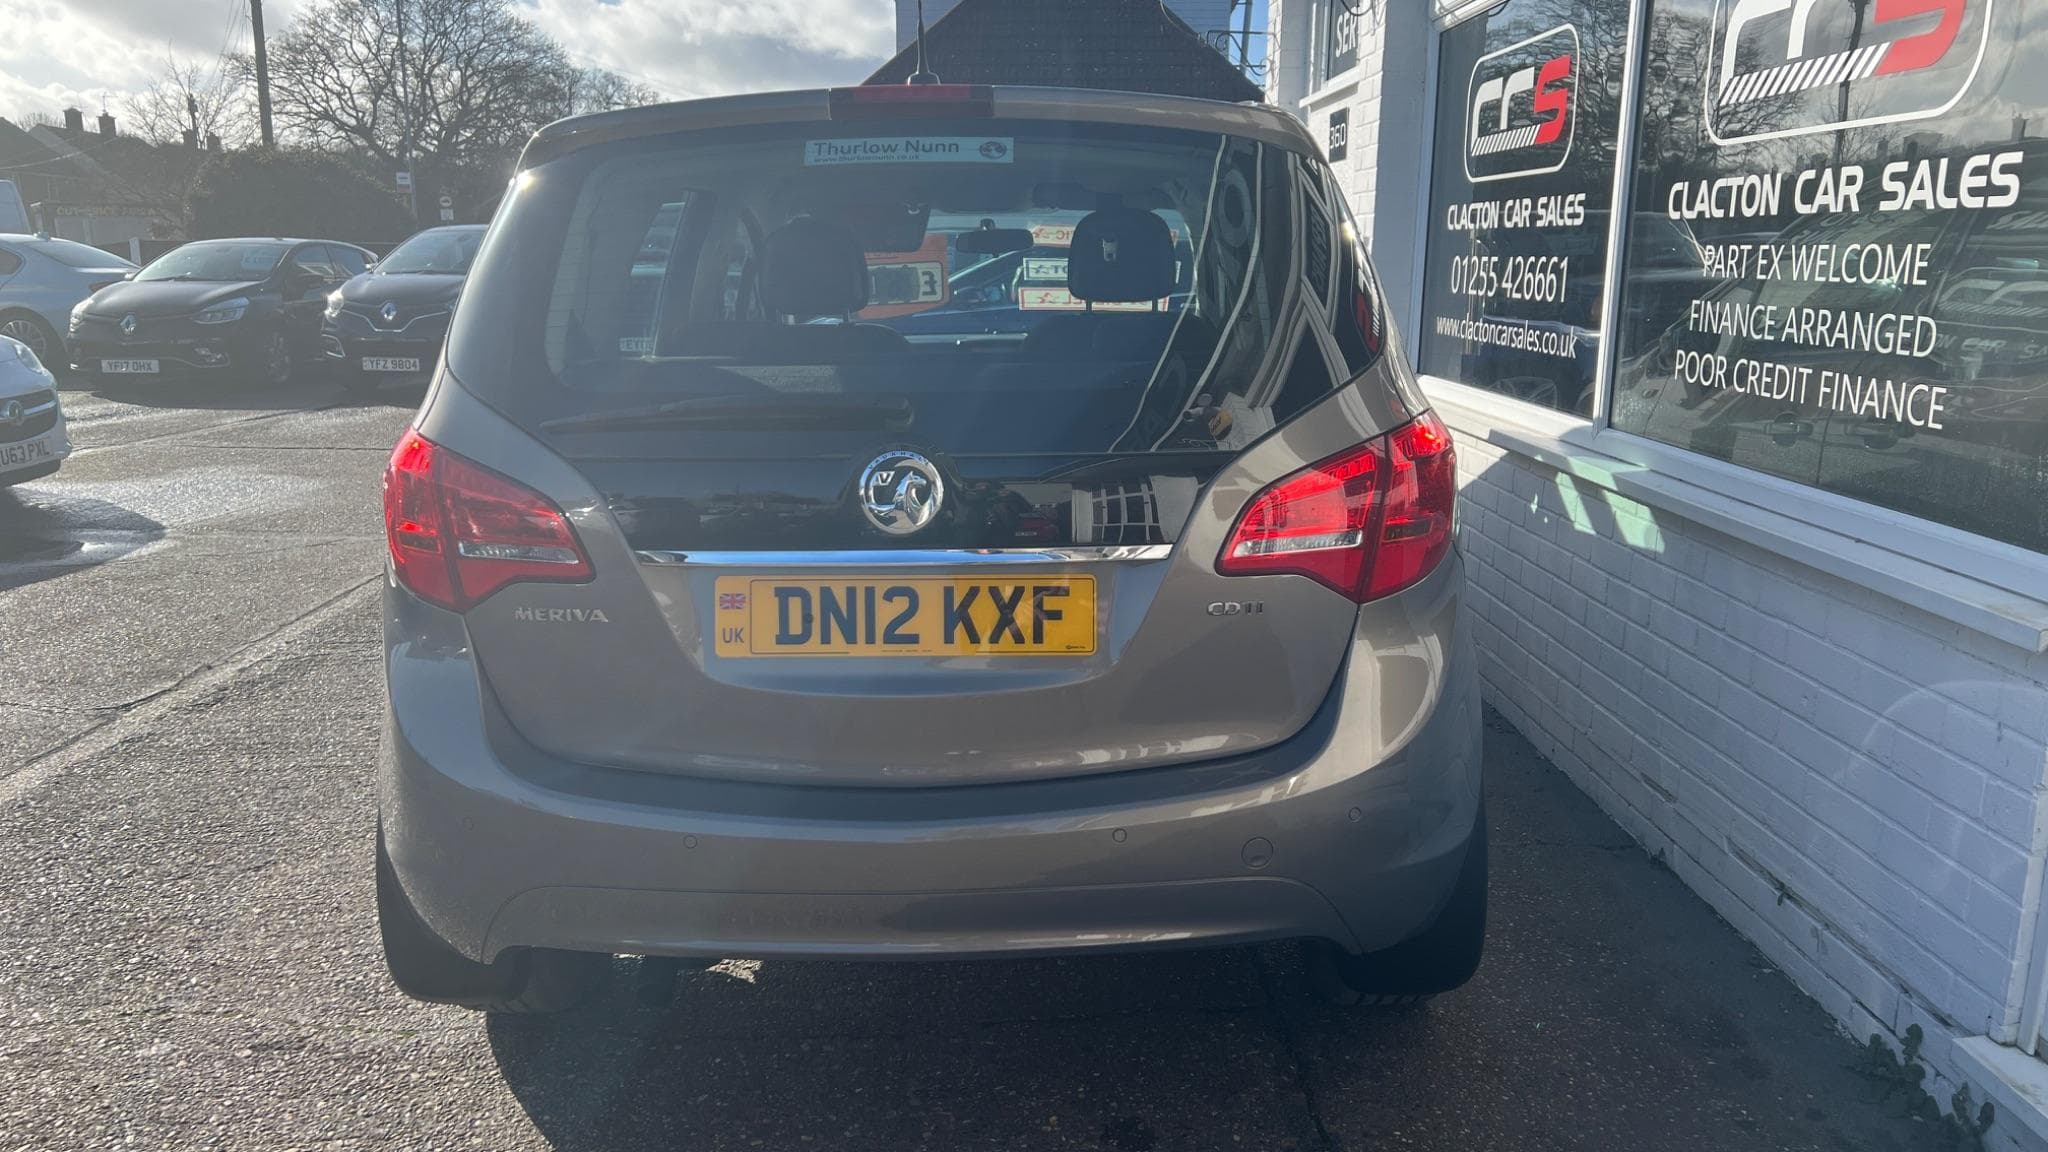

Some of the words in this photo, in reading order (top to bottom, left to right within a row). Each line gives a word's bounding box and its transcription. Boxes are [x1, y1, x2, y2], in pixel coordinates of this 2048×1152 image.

[813, 140, 899, 156] Thurlow
[905, 139, 960, 153] Nunn
[1329, 122, 1347, 149] 360
[1668, 173, 1782, 220] CLACTON
[1794, 165, 1864, 214] CAR
[1879, 151, 2024, 212] SALES
[1447, 201, 1500, 231] CLACTON
[1504, 197, 1531, 229] CAR
[1536, 193, 1586, 228] SALES
[1450, 255, 1499, 298] 01255
[1501, 256, 1570, 304] 426661
[1701, 243, 1753, 281] PART
[1756, 244, 1786, 281] EX
[1791, 243, 1931, 286] WELCOME
[1436, 313, 1577, 359] www.clactoncarsales.co.uk
[1689, 299, 1778, 341] FINANCE
[1781, 307, 1938, 358] ARRANGED
[1674, 349, 1727, 391] POOR
[1733, 360, 1813, 405] CREDIT
[1818, 371, 1947, 430] FINANCE
[0, 444, 26, 466] U63
[27, 440, 51, 461] PXL
[514, 606, 609, 623] MERIVA
[722, 627, 745, 644] UK
[773, 585, 920, 646] DN12
[943, 585, 1071, 646] KXF
